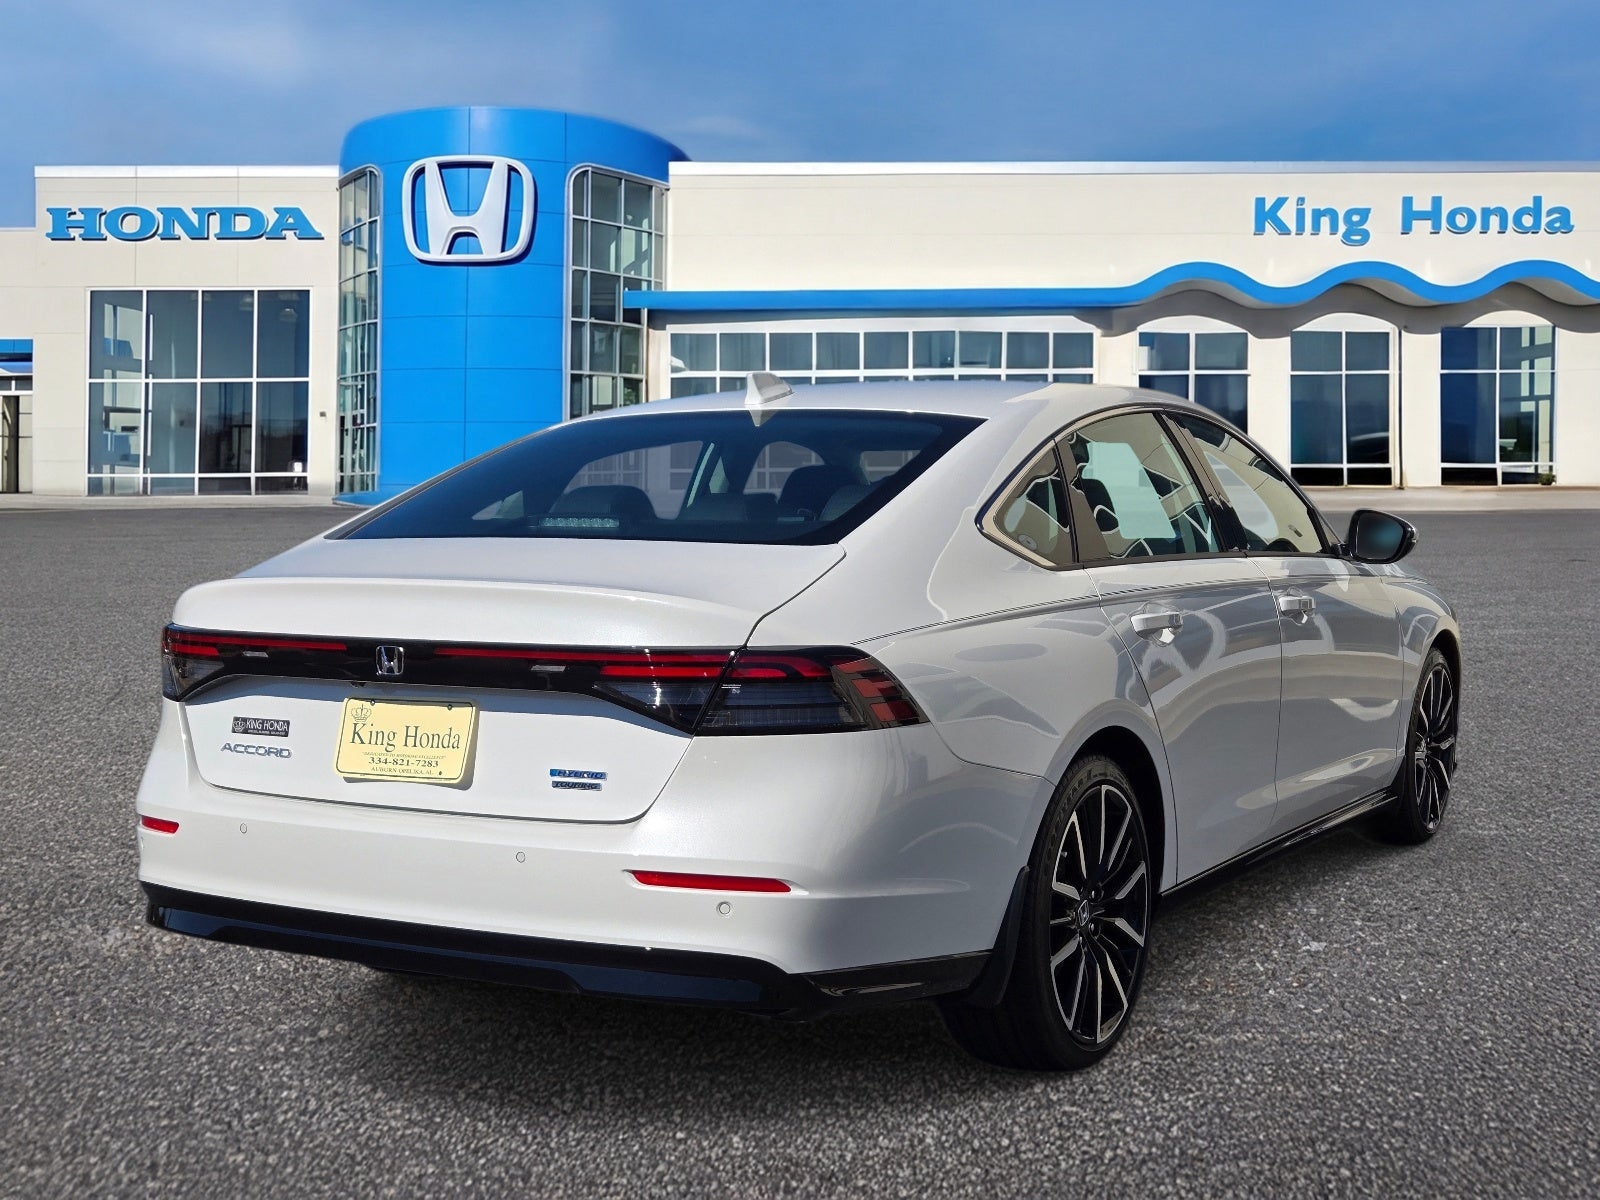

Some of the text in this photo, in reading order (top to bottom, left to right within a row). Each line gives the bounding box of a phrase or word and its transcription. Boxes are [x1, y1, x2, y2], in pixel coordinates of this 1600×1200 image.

[45, 206, 324, 242] HONDA
[1253, 195, 1575, 246] King Honda
[246, 719, 288, 732] KING HONDA
[350, 722, 461, 752] King Honda
[220, 742, 292, 758] ACCORD
[368, 757, 439, 768] 334-821-7283
[557, 769, 606, 779] HYBRID
[552, 781, 601, 790] TOURING
